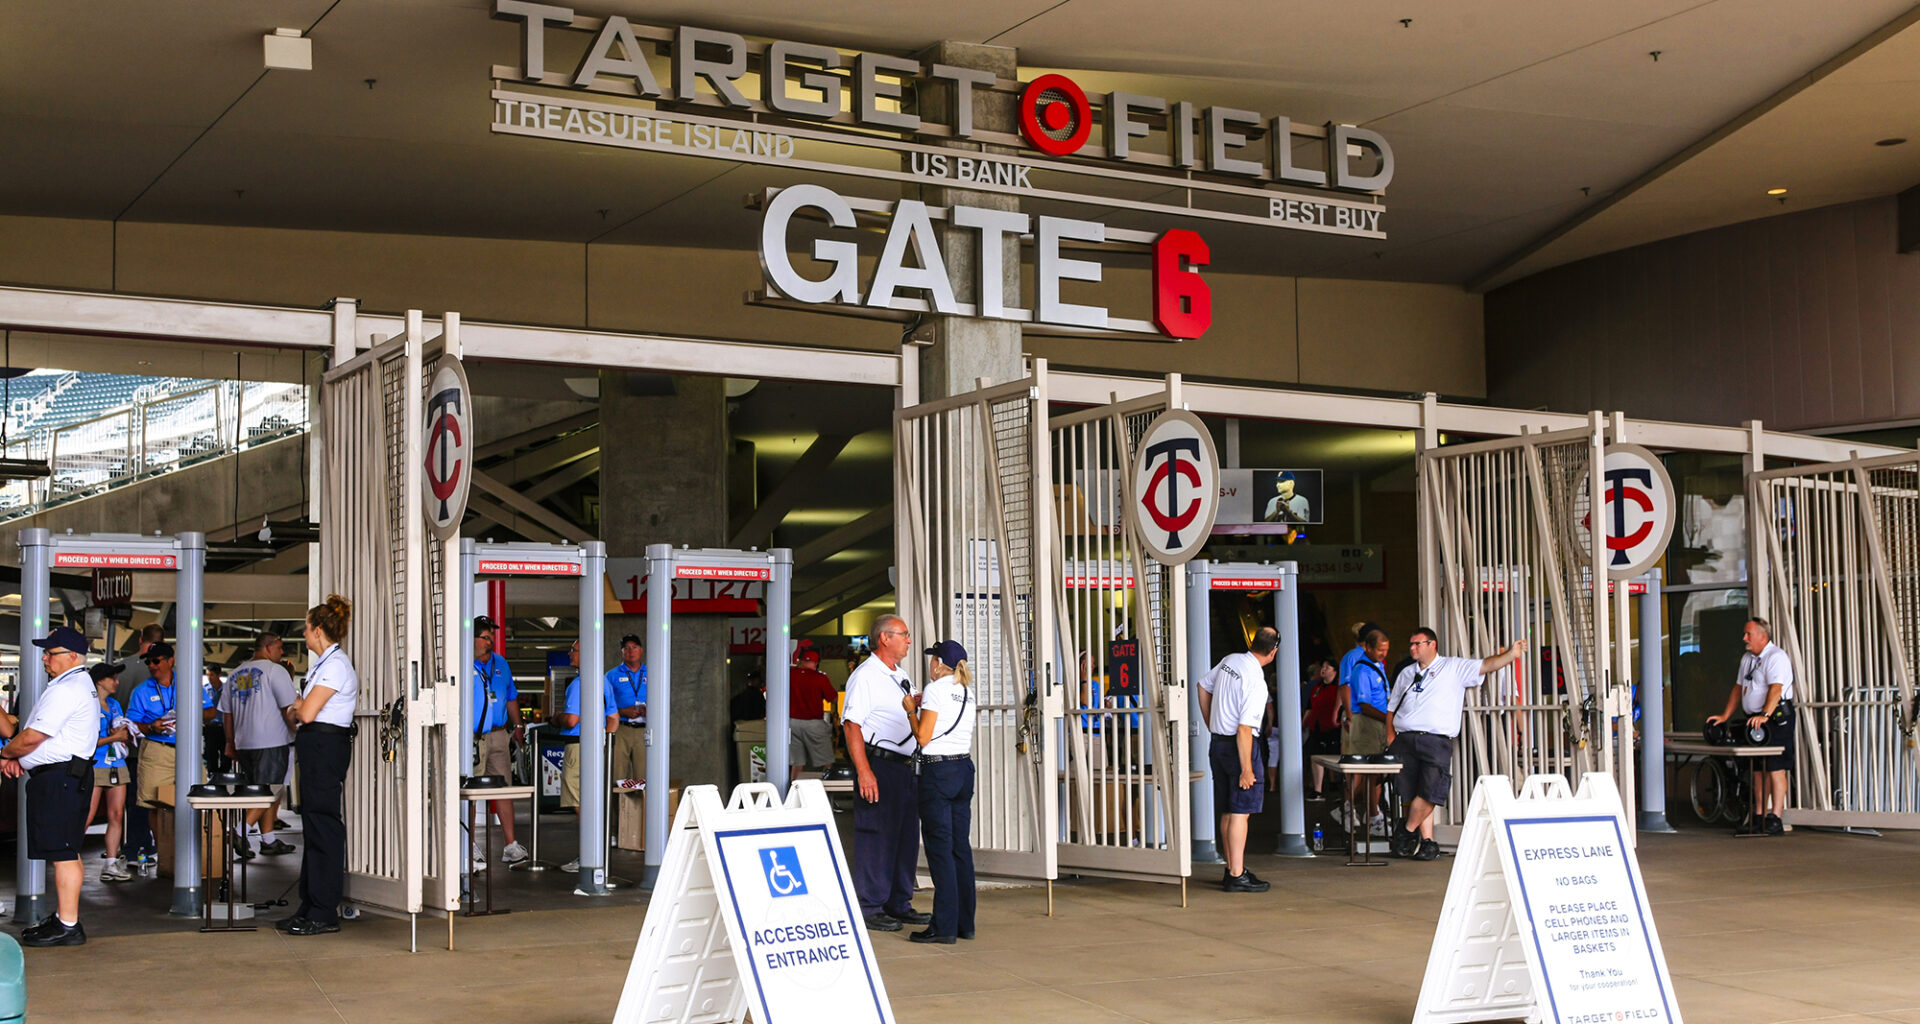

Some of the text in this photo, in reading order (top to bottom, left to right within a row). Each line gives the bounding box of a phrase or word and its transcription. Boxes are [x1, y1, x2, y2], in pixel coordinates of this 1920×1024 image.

[495, 0, 1395, 191] TARGET FIELD
[498, 101, 795, 159] TREASURE ISLAND
[911, 152, 1034, 189] US BANK
[1269, 198, 1380, 233] BEST BUY
[760, 184, 1212, 340] GATE 6
[58, 555, 161, 565] PROCEED ONLY WHEN DIRECTED
[508, 563, 524, 571] ONLY
[541, 564, 569, 572] DIRECTED
[678, 568, 703, 576] PROCEED
[717, 569, 733, 577] WHEN
[96, 568, 131, 600] barrio
[1112, 643, 1136, 657] GATE
[1120, 663, 1129, 688] 6
[1524, 845, 1614, 861] EXPRESS LANE
[1556, 875, 1598, 886] NO BAGS
[1549, 901, 1618, 914] PLEASE PLACE
[1545, 914, 1629, 928] CELL PHONES AND
[754, 920, 849, 946] ACCESSIBLE
[1551, 927, 1630, 942] LARGER ITEMS IN
[1573, 942, 1616, 954] BASKETS
[766, 944, 850, 969] ENTRANCE
[1579, 968, 1623, 979] Thank You
[1568, 1009, 1658, 1024] TARGET FIELD
